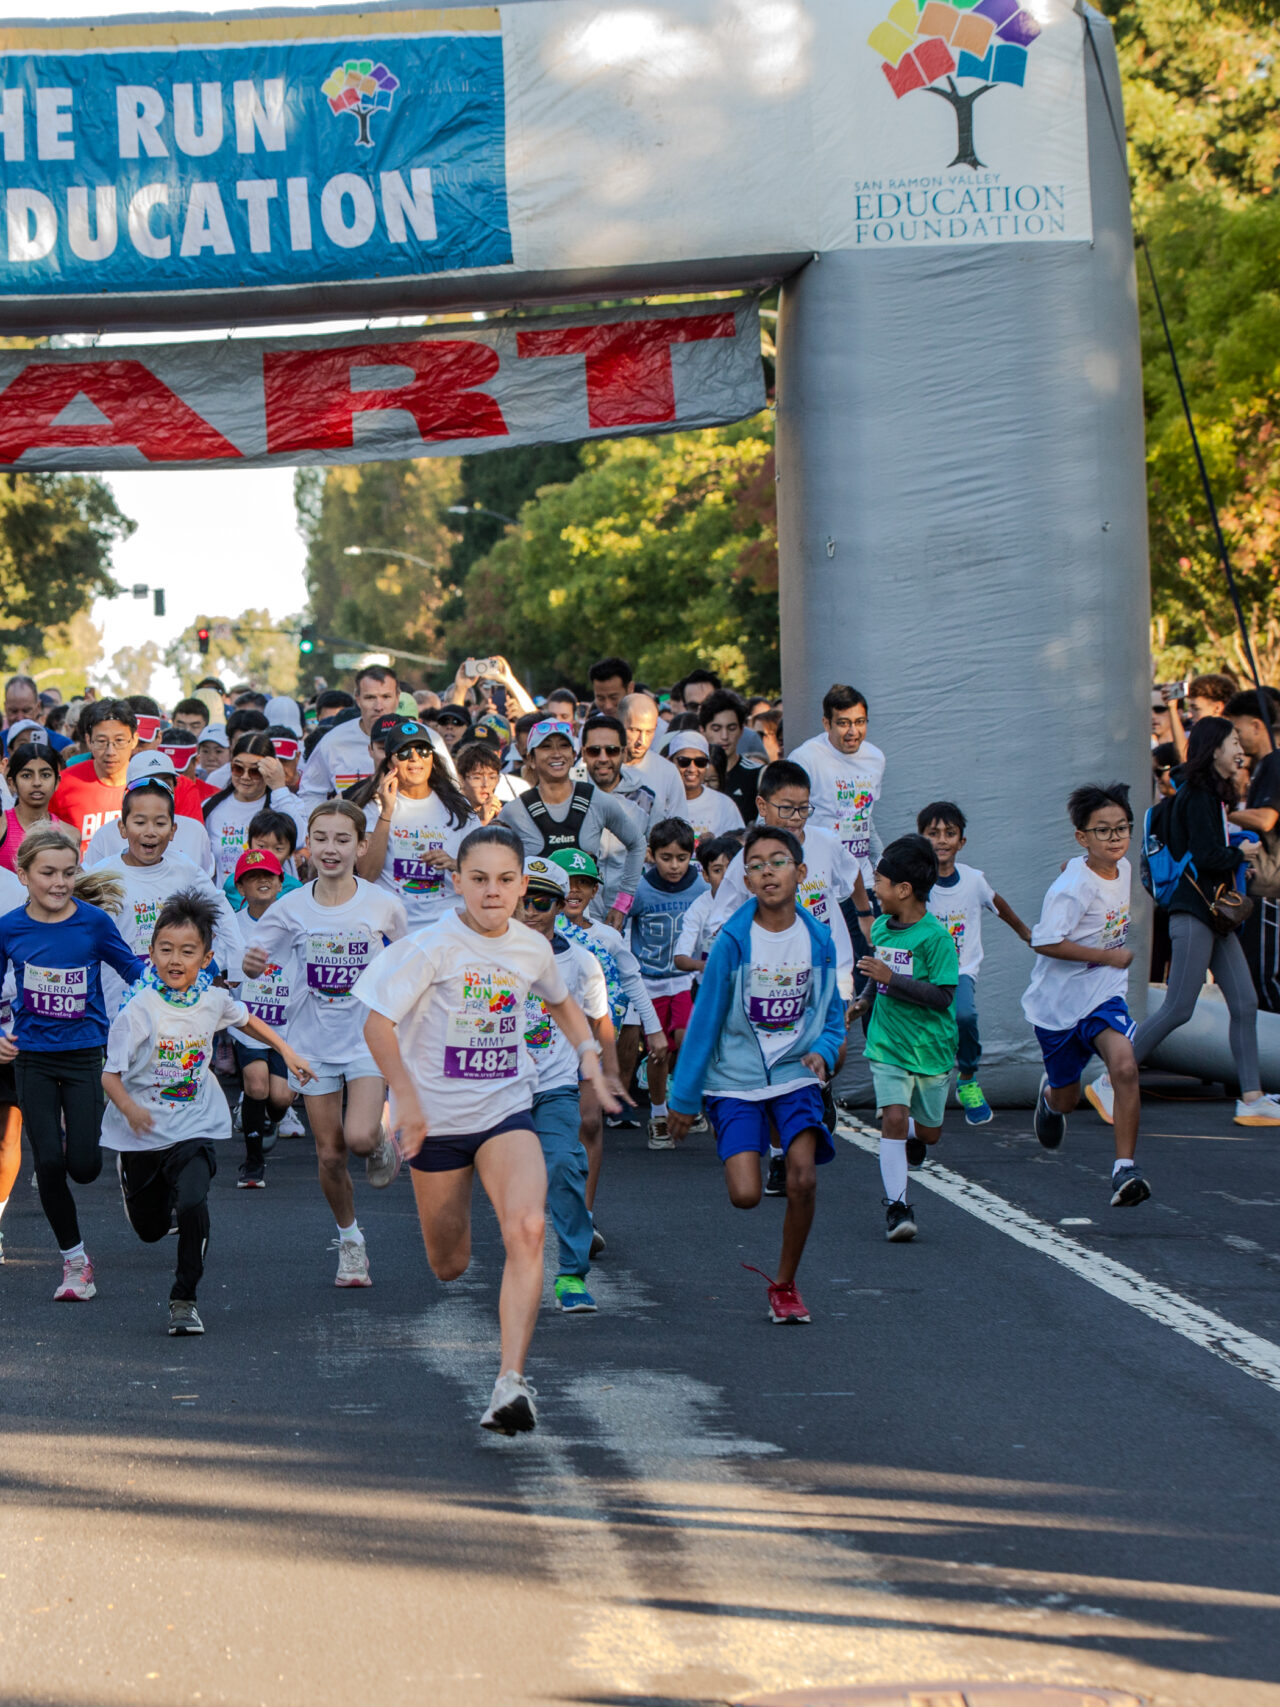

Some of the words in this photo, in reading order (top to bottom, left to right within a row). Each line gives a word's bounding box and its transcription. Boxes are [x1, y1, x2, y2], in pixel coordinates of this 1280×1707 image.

[116, 78, 286, 158] RUN
[854, 180, 883, 192] SAN
[889, 176, 943, 190] RAMON
[948, 173, 1000, 185] VALLEY
[854, 184, 1065, 221] EDUCATION
[856, 213, 1065, 244] FOUNDATION
[837, 790, 855, 800] RUN
[222, 826, 244, 837] 42nd
[394, 829, 419, 839] 42nd
[221, 836, 244, 847] RUN
[549, 835, 575, 844] Zelus
[801, 880, 827, 893] ANNUAL
[134, 902, 156, 914] 42nd
[644, 896, 692, 912] CONNECTI
[815, 902, 825, 916] 5K
[135, 912, 157, 924] RUN
[351, 943, 366, 954] 5K
[315, 955, 363, 965] MADISON
[894, 952, 909, 963] 5K
[67, 972, 81, 983] 5K
[314, 966, 360, 984] 1729
[464, 971, 491, 987] 42nd
[38, 983, 74, 994] SIERRA
[278, 986, 288, 996] 5K
[463, 985, 492, 1000] RUN
[769, 988, 801, 997] AYAAN
[30, 992, 76, 1013] 1130
[255, 996, 280, 1004] KIAAN
[465, 1000, 485, 1009] FOR
[251, 1004, 278, 1019] 711
[758, 997, 803, 1017] 1697
[502, 1019, 515, 1032] 5K
[159, 1040, 184, 1051] 42nd
[469, 1037, 505, 1047] EMMY
[158, 1049, 182, 1061] RUN
[455, 1049, 508, 1072] 1482
[154, 1067, 191, 1079] education
